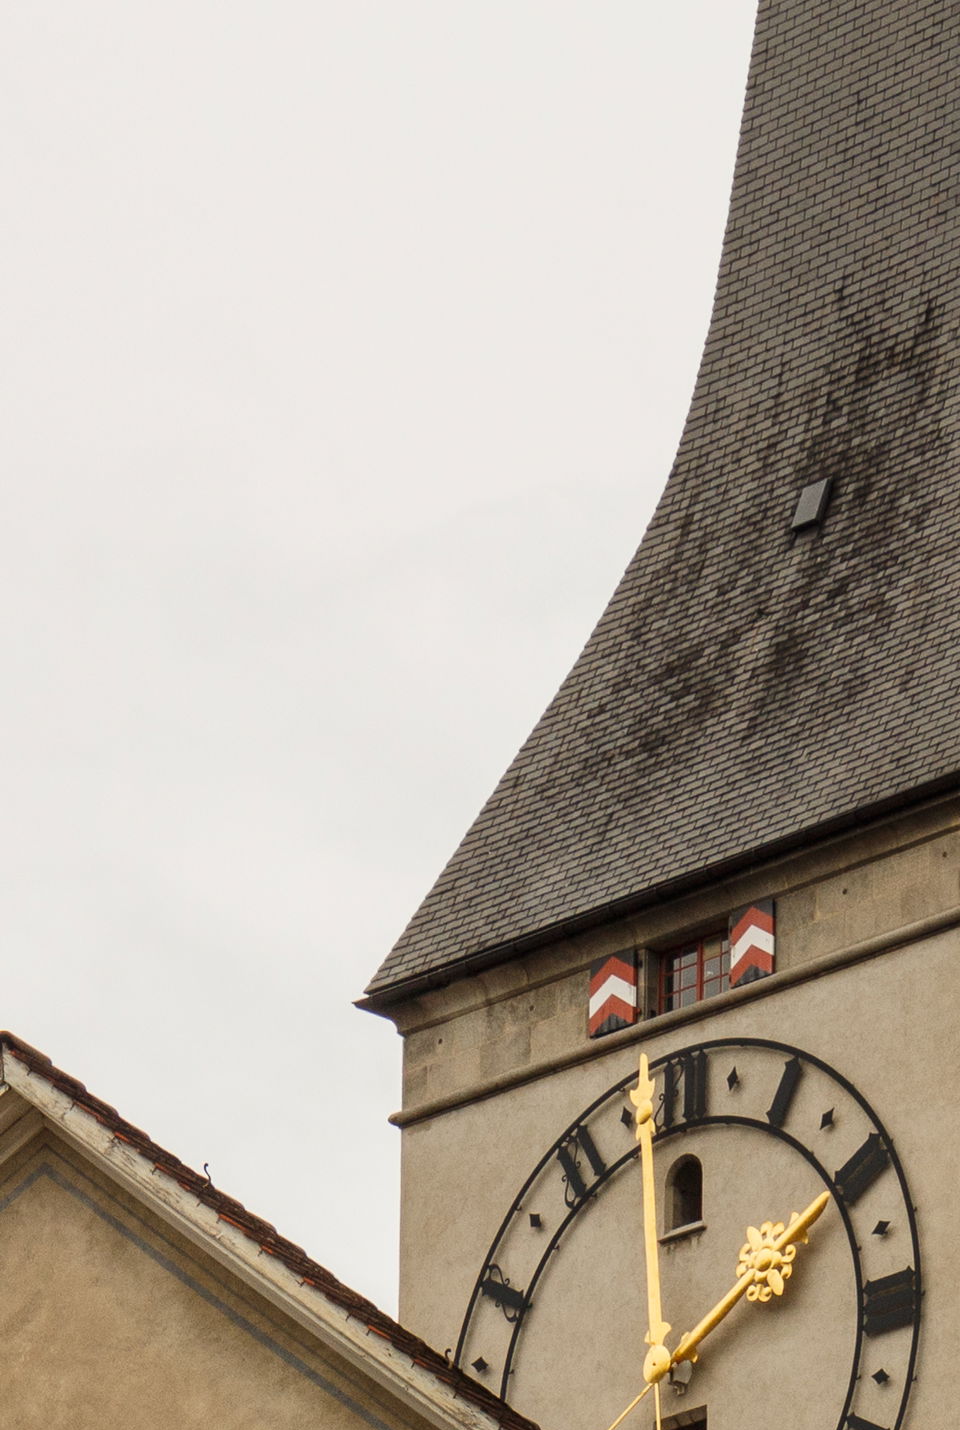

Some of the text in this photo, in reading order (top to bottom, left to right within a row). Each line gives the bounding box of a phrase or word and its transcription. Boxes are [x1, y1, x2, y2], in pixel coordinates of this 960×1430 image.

[655, 1049, 708, 1129] XII
[766, 1055, 803, 1128] I
[561, 1124, 607, 1209] XI
[834, 1131, 888, 1204] II
[863, 1265, 917, 1337] III
